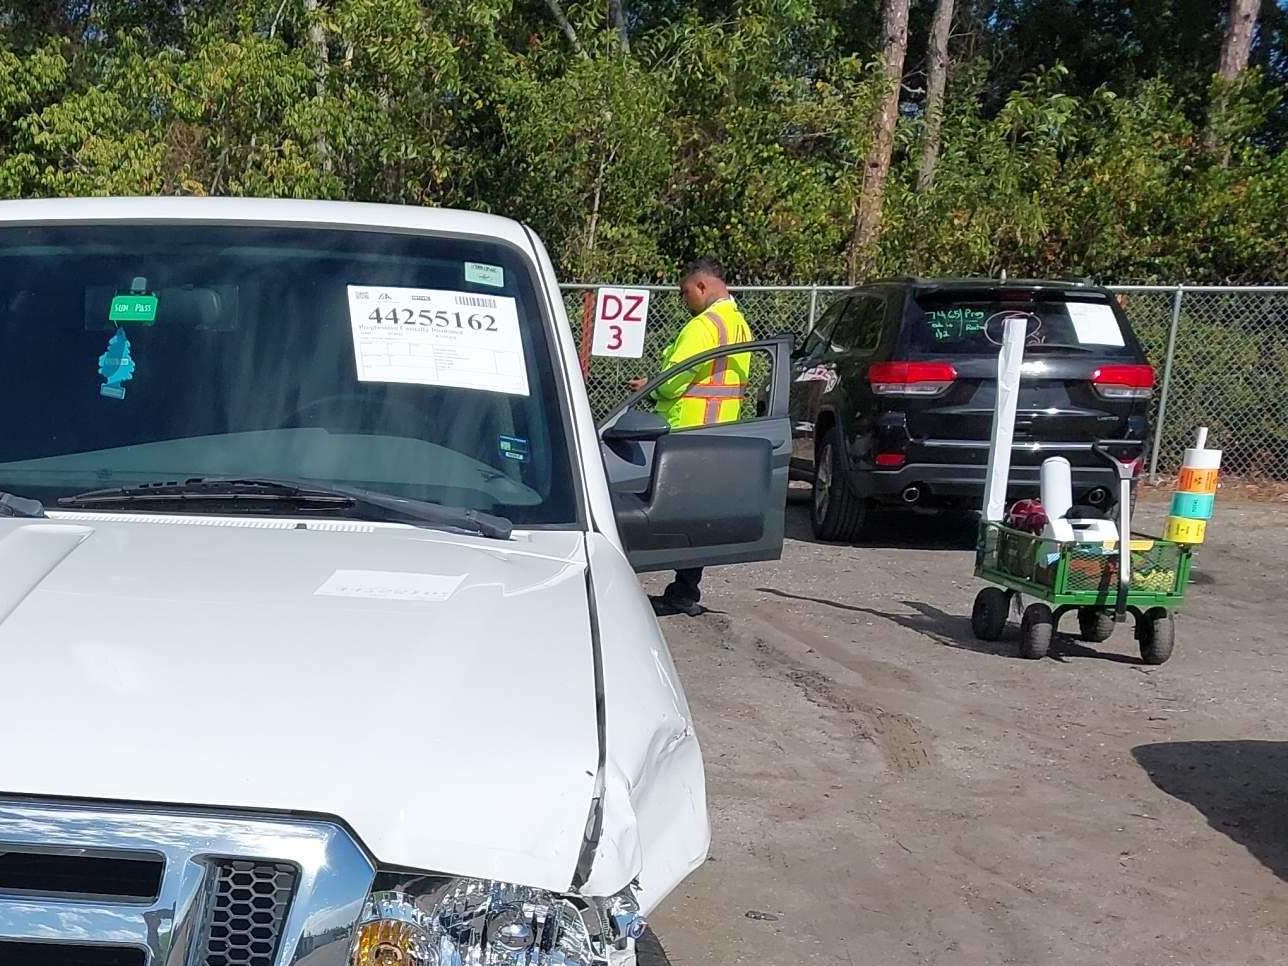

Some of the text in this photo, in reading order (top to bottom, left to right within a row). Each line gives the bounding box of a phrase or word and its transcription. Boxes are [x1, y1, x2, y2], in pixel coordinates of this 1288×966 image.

[368, 307, 498, 332] 44255162
[601, 294, 644, 322] DZ
[606, 325, 622, 350] 3
